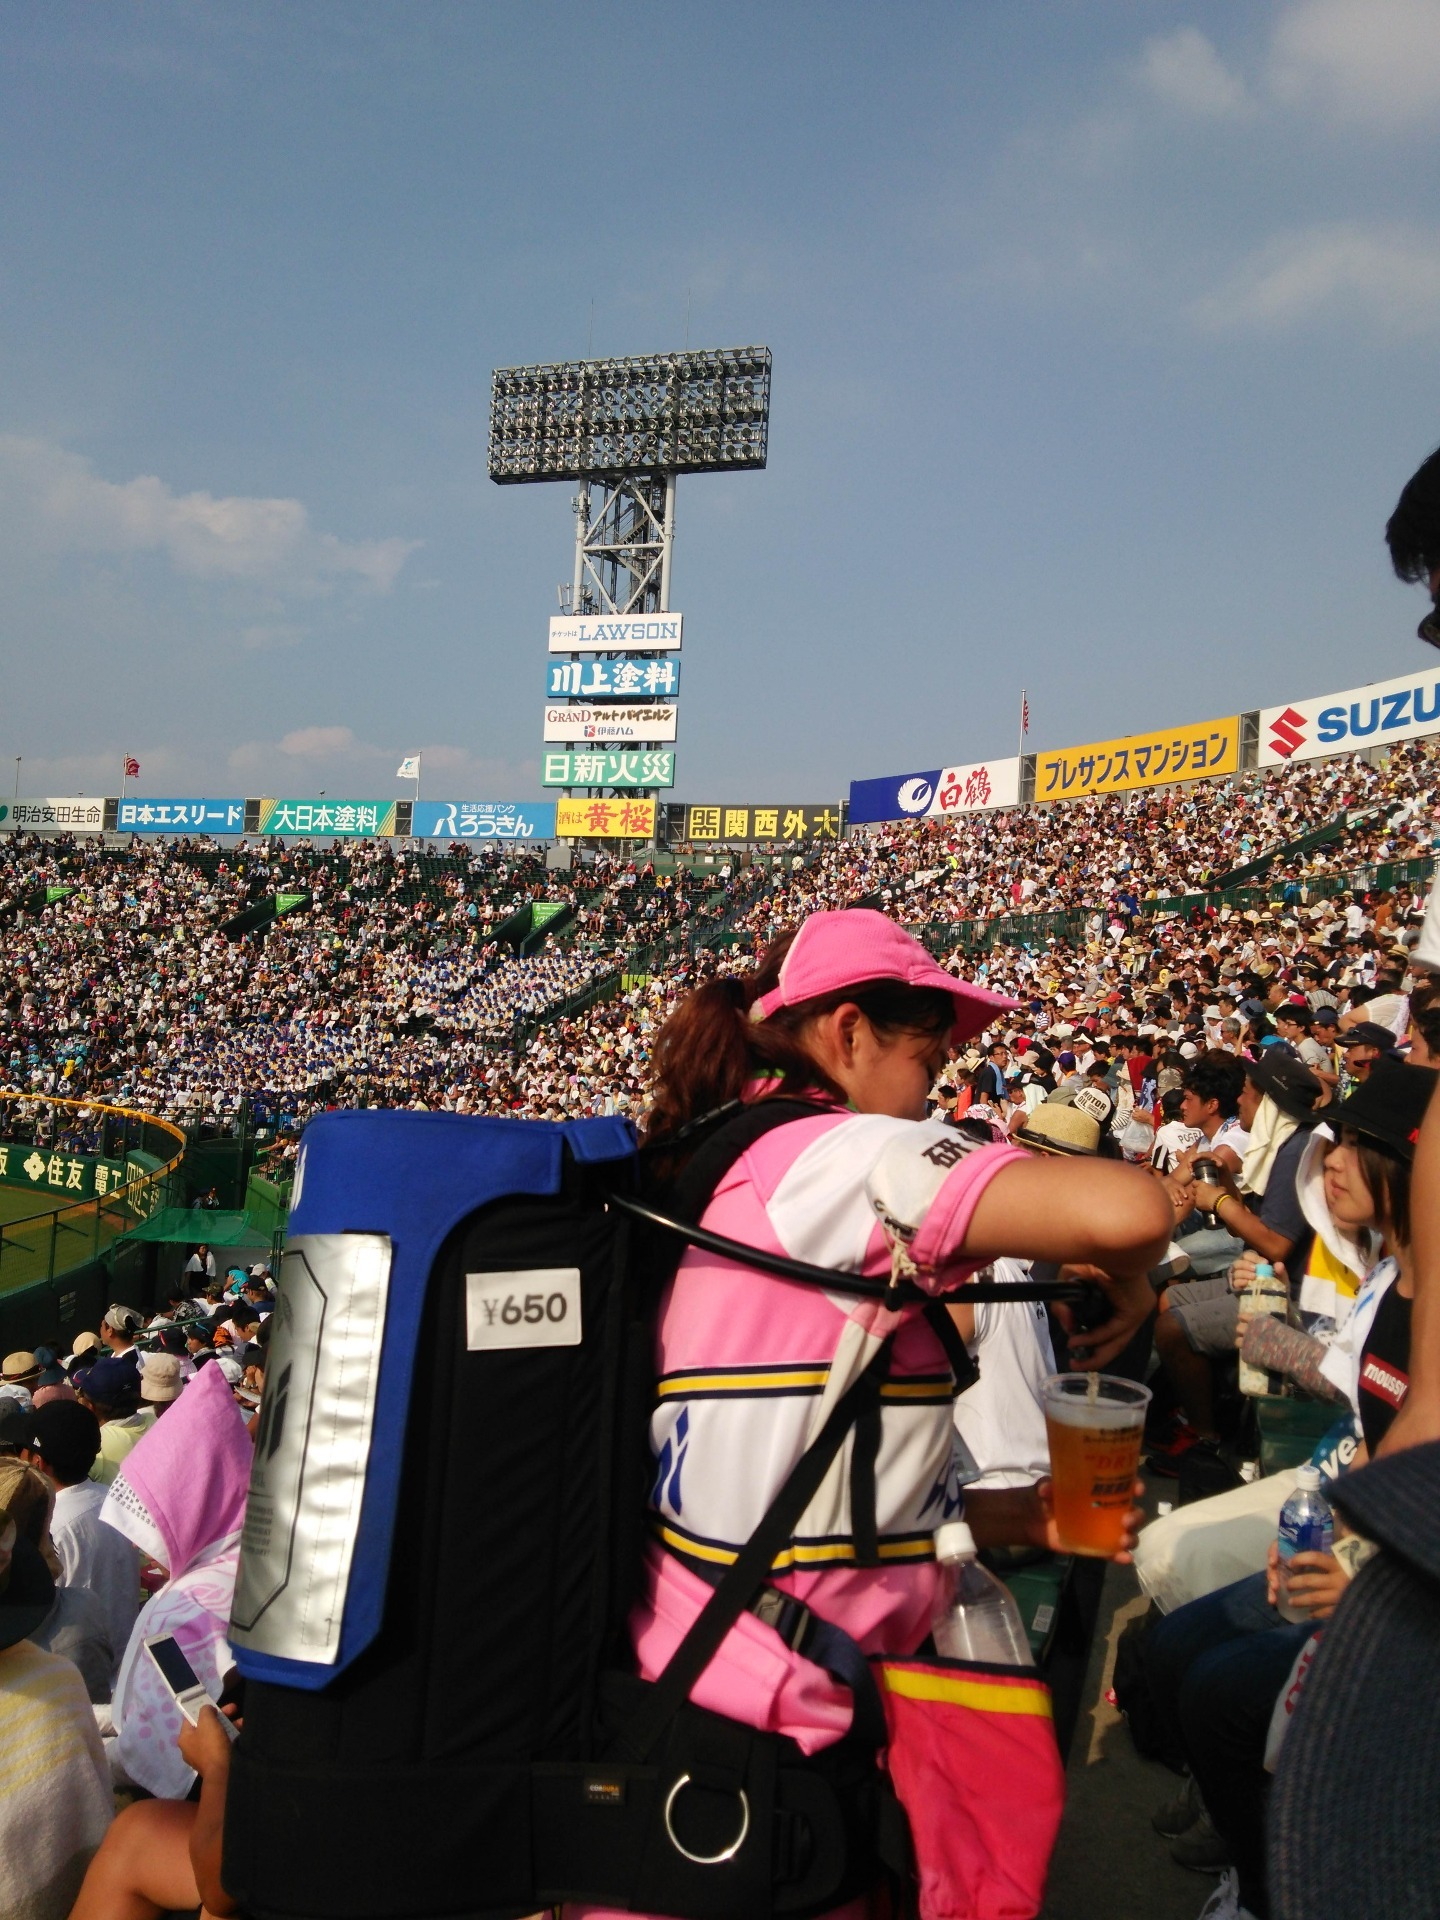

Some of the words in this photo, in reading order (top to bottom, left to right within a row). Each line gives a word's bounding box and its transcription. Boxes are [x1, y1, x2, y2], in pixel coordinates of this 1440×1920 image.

[578, 622, 678, 641] LAWSON
[551, 661, 676, 695] 川上塗料
[547, 709, 591, 723] GRAND
[592, 708, 674, 723] アルトバイエルン
[1317, 682, 1440, 743] SUZU
[597, 726, 634, 736] 伊藤ハム
[545, 753, 671, 783] 日新火災
[1045, 732, 1229, 792] プレサンスマンション
[938, 766, 992, 811] 白鶴
[12, 805, 101, 823] 明治安田生命
[121, 804, 243, 826] 日本エスリード
[274, 804, 378, 833] 大日本塗料
[461, 803, 516, 814] 生活応援バンク
[724, 808, 839, 838] 関西外大
[459, 814, 534, 837] ろうきん
[1078, 1095, 1087, 1107] OIL
[1082, 1090, 1107, 1111] MOTOR
[47, 1155, 84, 1190] 住友
[482, 1292, 568, 1326] ¥650
[1362, 1362, 1407, 1402] moussy
